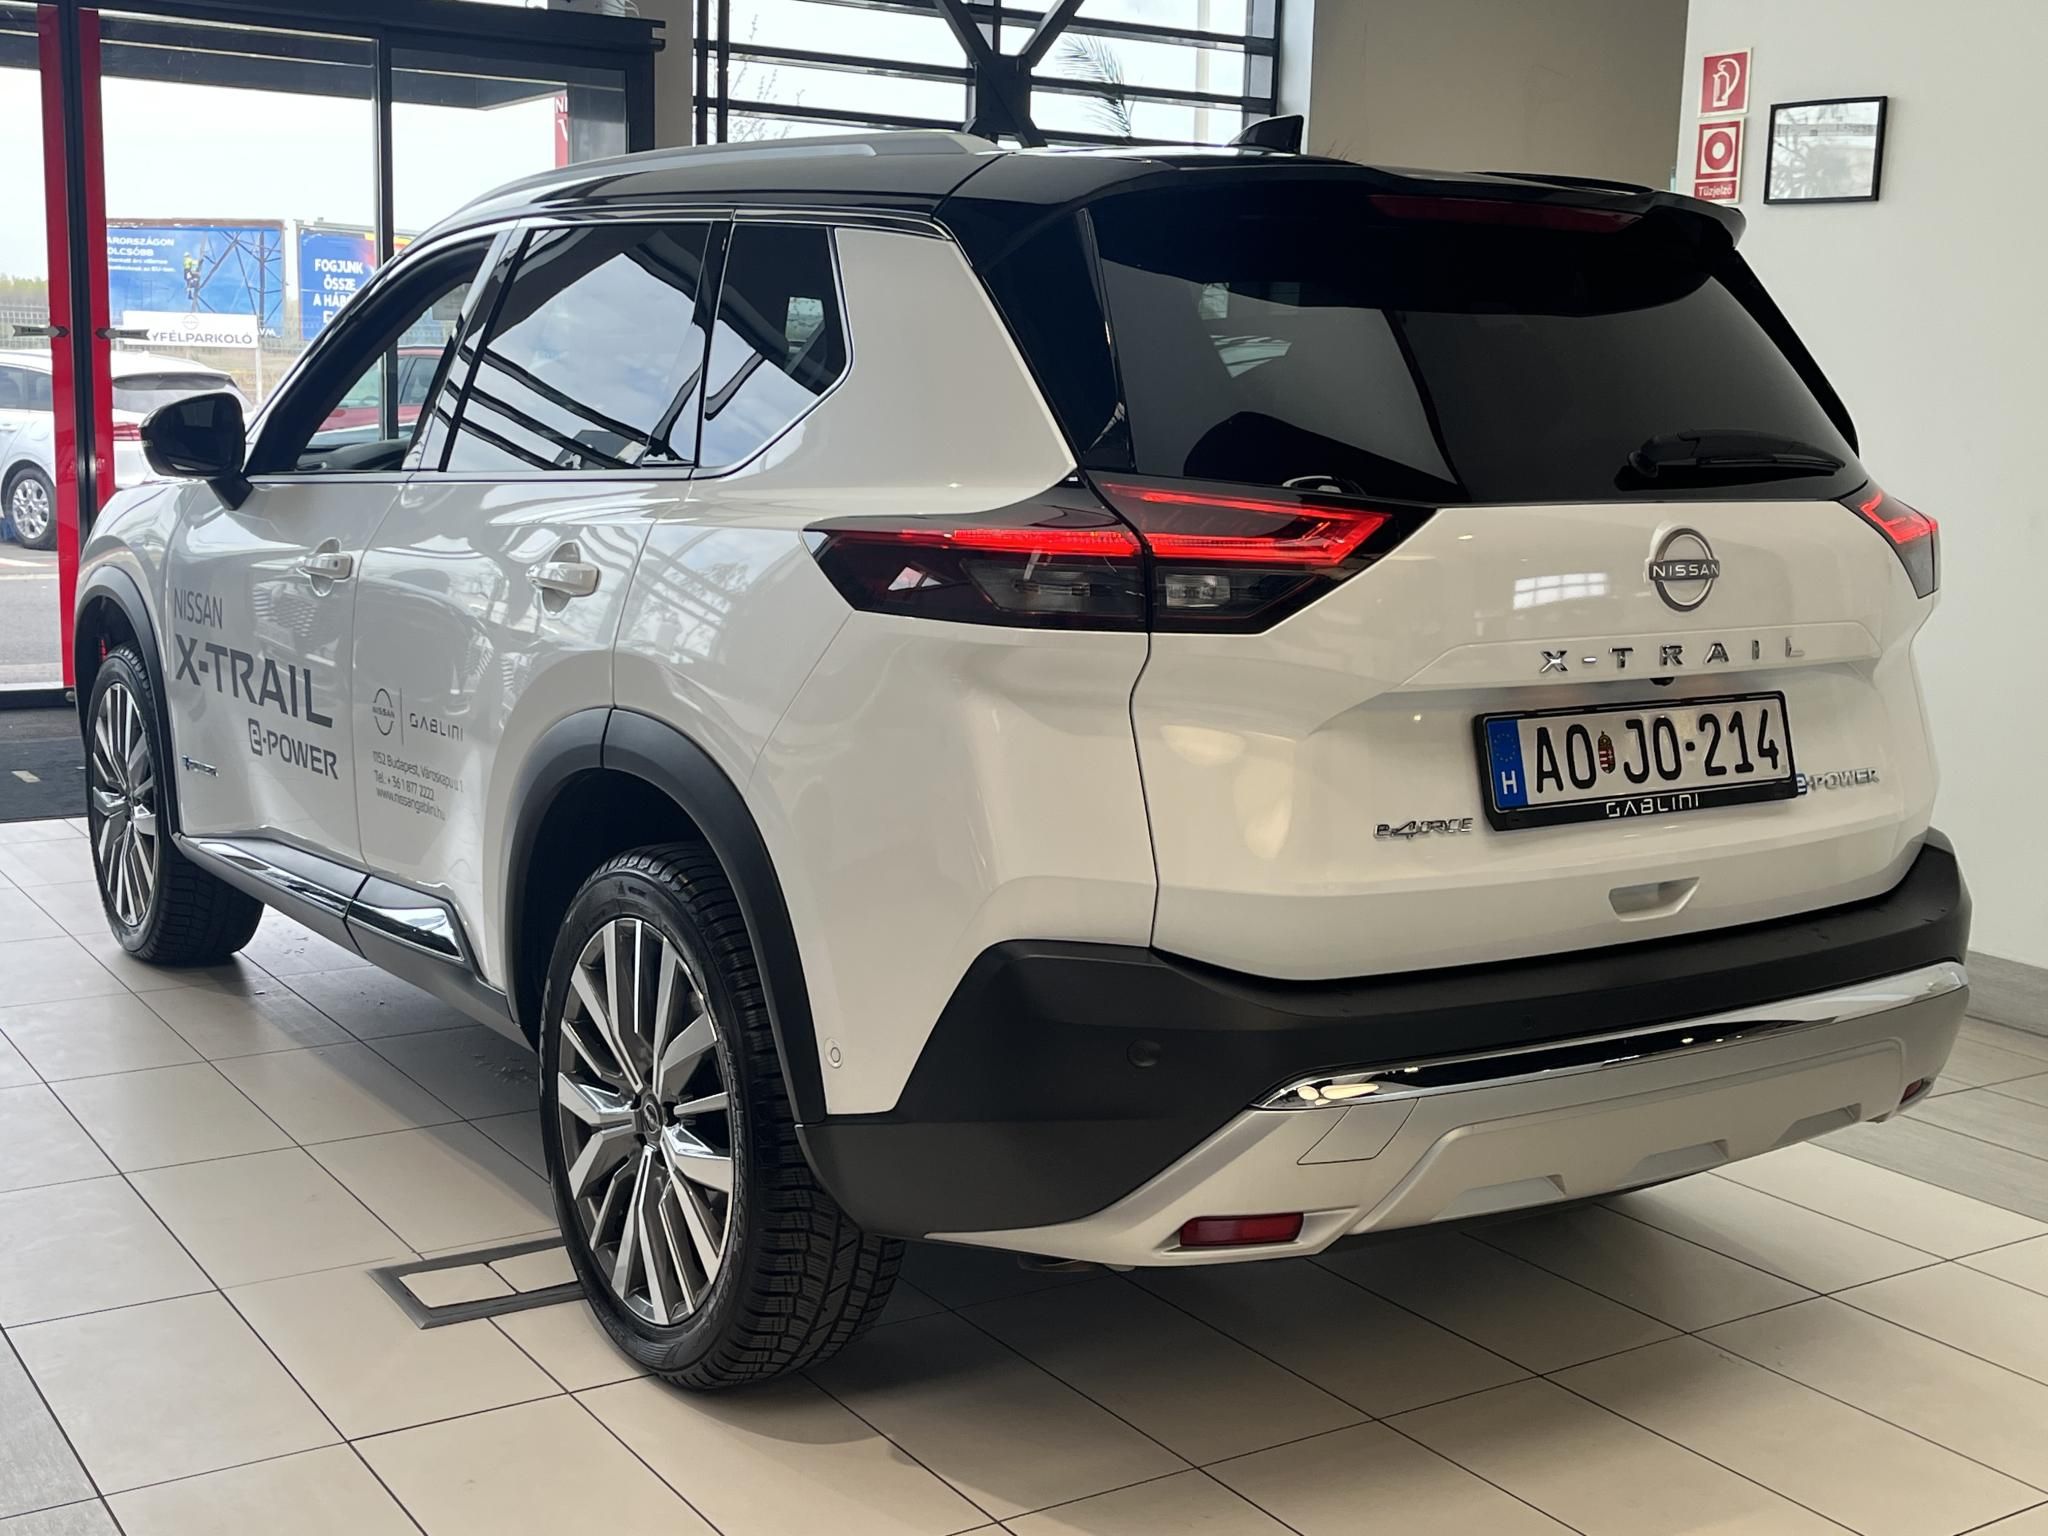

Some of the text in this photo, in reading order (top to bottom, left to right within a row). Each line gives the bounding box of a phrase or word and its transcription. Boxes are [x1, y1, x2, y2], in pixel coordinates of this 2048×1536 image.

[314, 258, 364, 275] FOGJUNK
[323, 274, 357, 291] ÖSSZE
[313, 293, 322, 307] A
[1652, 560, 1720, 579] NISSAN
[174, 588, 223, 630] NISSAN
[1538, 634, 1807, 674] X-TRAIL
[175, 633, 334, 729] X-TRAIL
[372, 706, 396, 719] NISSAN
[409, 712, 464, 742] GABLINI
[248, 717, 339, 780] e-POWER
[1501, 770, 1517, 795] H
[1605, 792, 1700, 818] GABLINI
